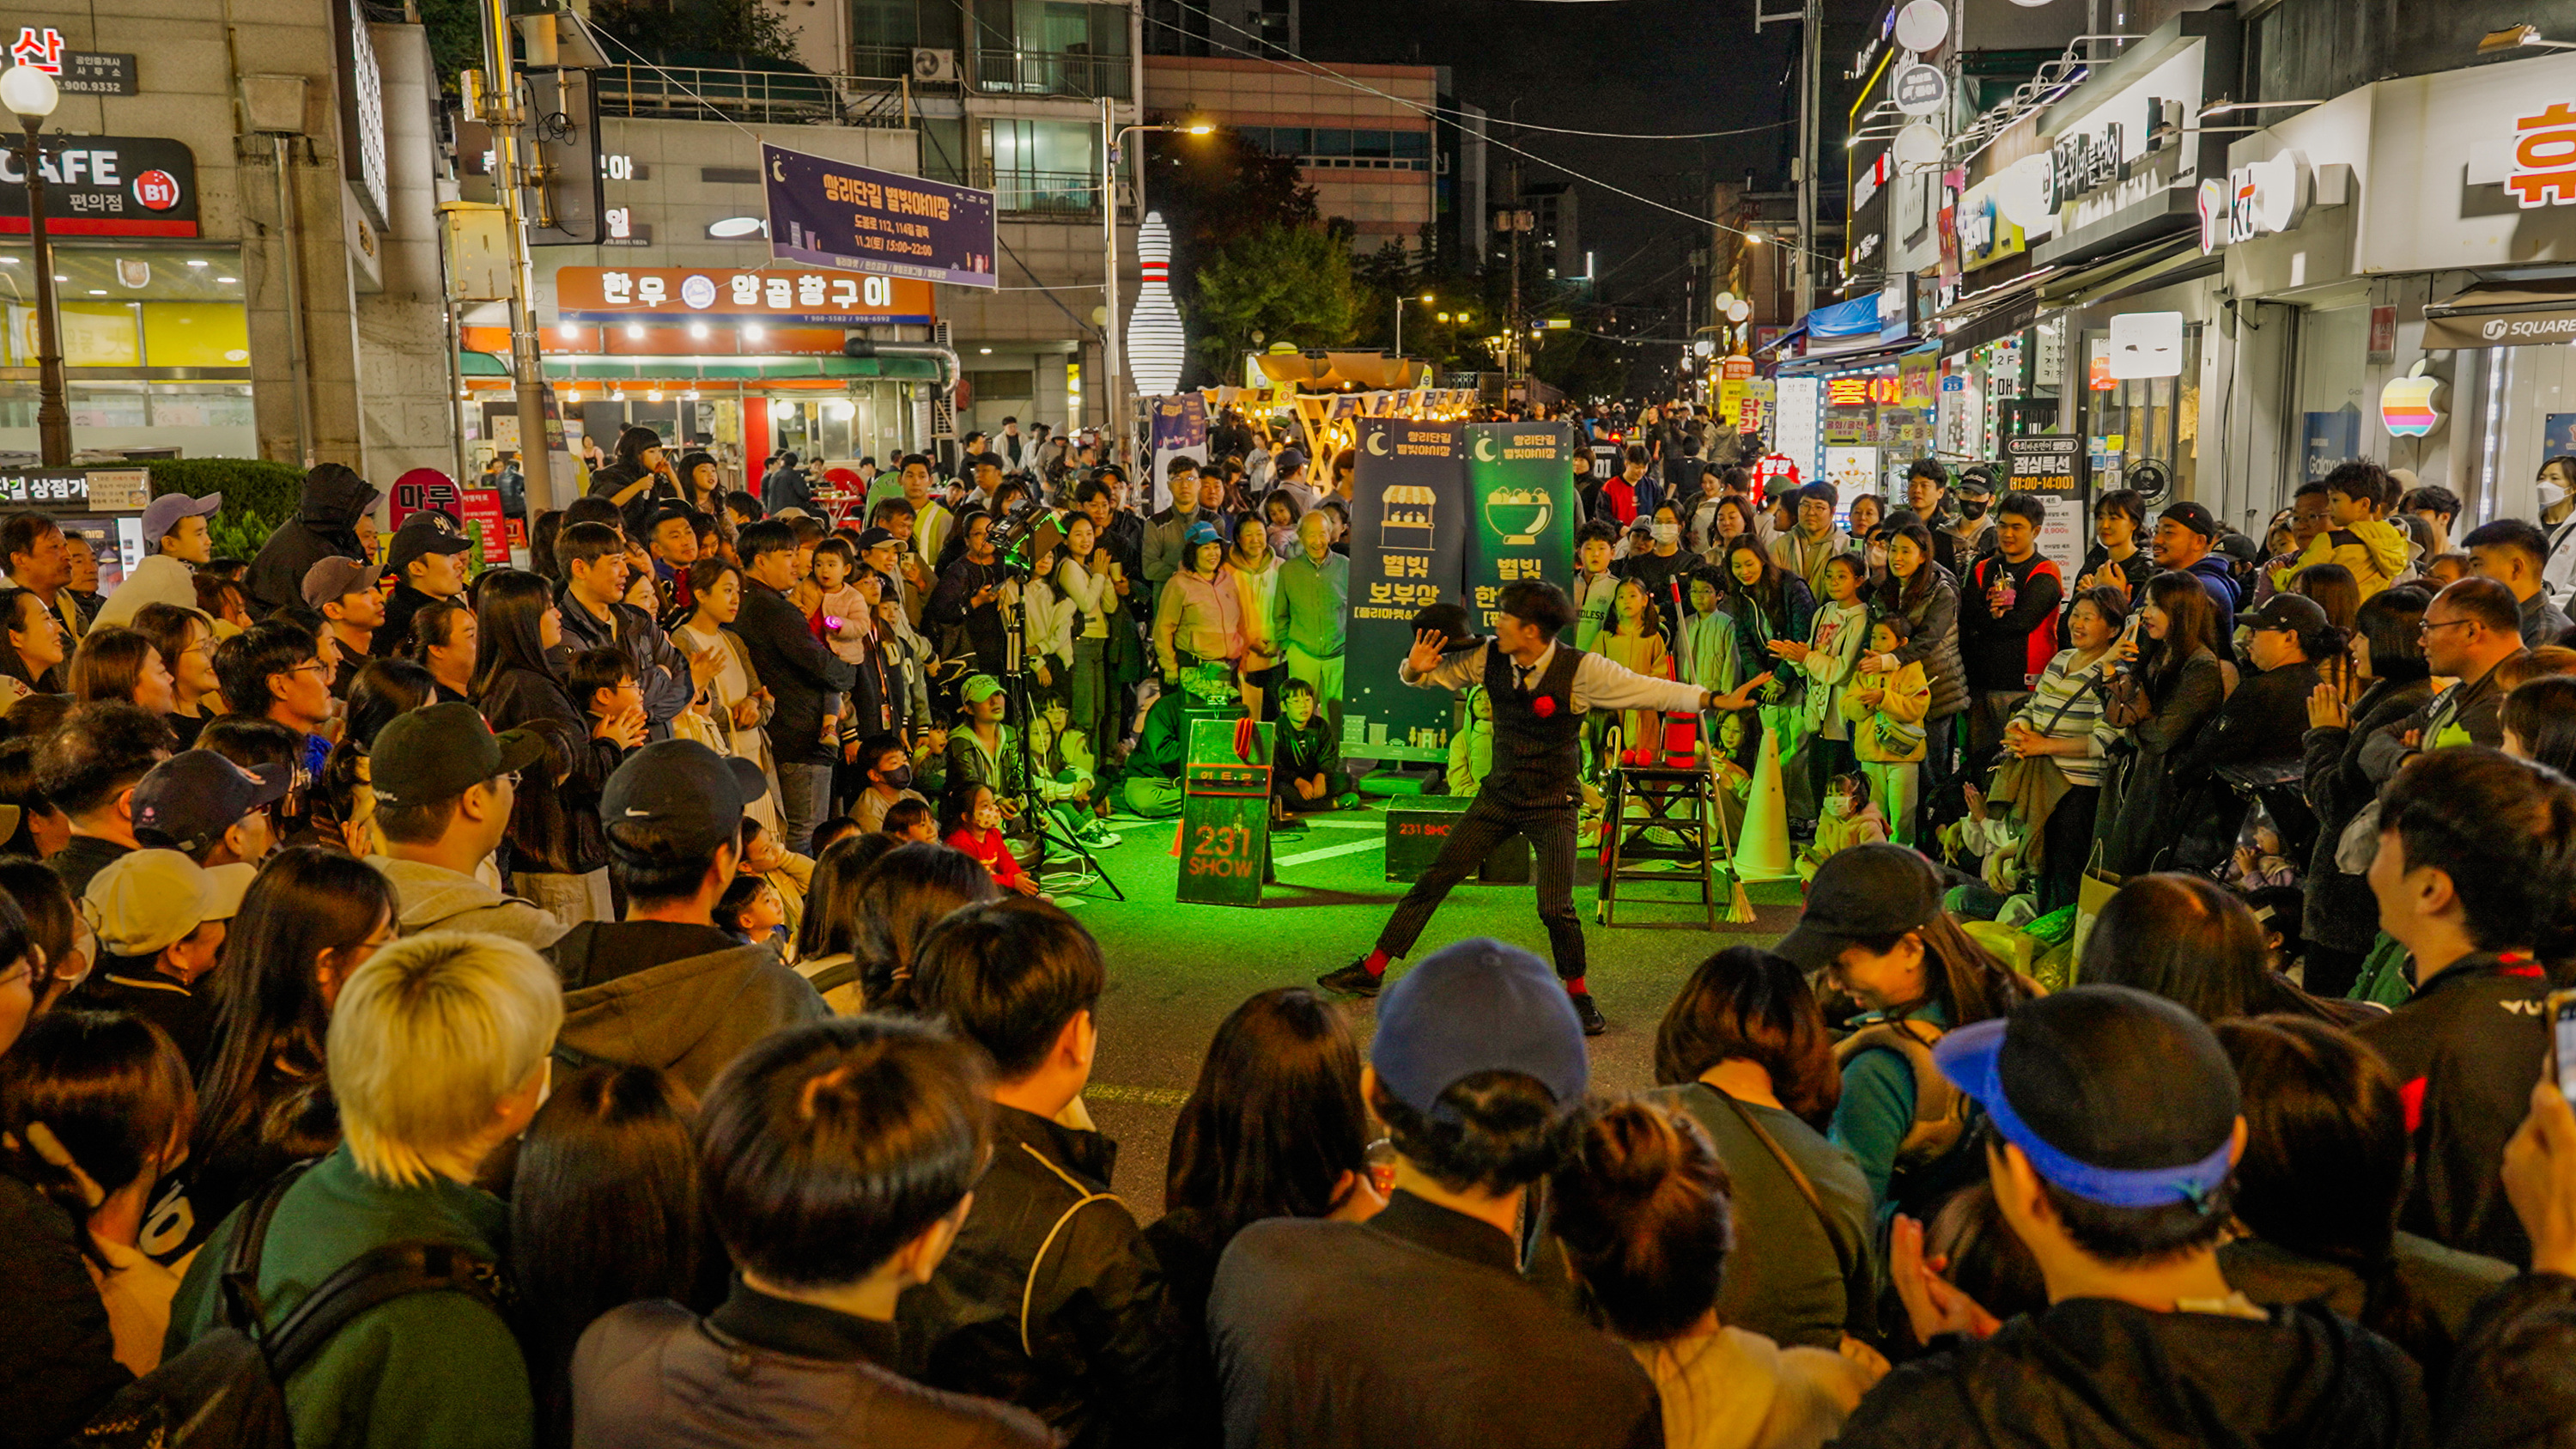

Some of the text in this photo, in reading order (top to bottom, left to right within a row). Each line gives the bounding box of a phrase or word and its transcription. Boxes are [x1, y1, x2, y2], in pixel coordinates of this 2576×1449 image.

[0, 28, 64, 75] 산
[76, 56, 120, 66] 공인중개사
[55, 80, 121, 92] 2.900.9332
[70, 194, 123, 211] 편의점
[144, 184, 169, 201] B1
[884, 186, 950, 221] 별빛야시장
[854, 214, 929, 239] 도봉로 112, 114길 골목
[854, 234, 884, 251] 11.2(토)
[603, 271, 666, 307] 한우
[731, 275, 890, 309] 양곱창구이
[2510, 319, 2576, 337] SQUARE
[1407, 431, 1451, 444] 쌍리단길
[1513, 435, 1556, 446] 쌍리단길
[1397, 444, 1451, 457] 별빛야시장
[1504, 447, 1556, 460] 별빛야시장
[1594, 459, 1612, 478] 01
[2014, 455, 2070, 474] 점심특선
[30, 478, 89, 499] 상점가
[398, 485, 455, 510] 마루
[1383, 555, 1429, 578] 별빛
[1498, 559, 1541, 580] 별빛
[1369, 582, 1440, 606] 보부상
[1475, 586, 1503, 608] 한
[1399, 823, 1451, 837] 231 SHO
[1194, 825, 1251, 857] 231
[1188, 857, 1254, 878] SHOW
